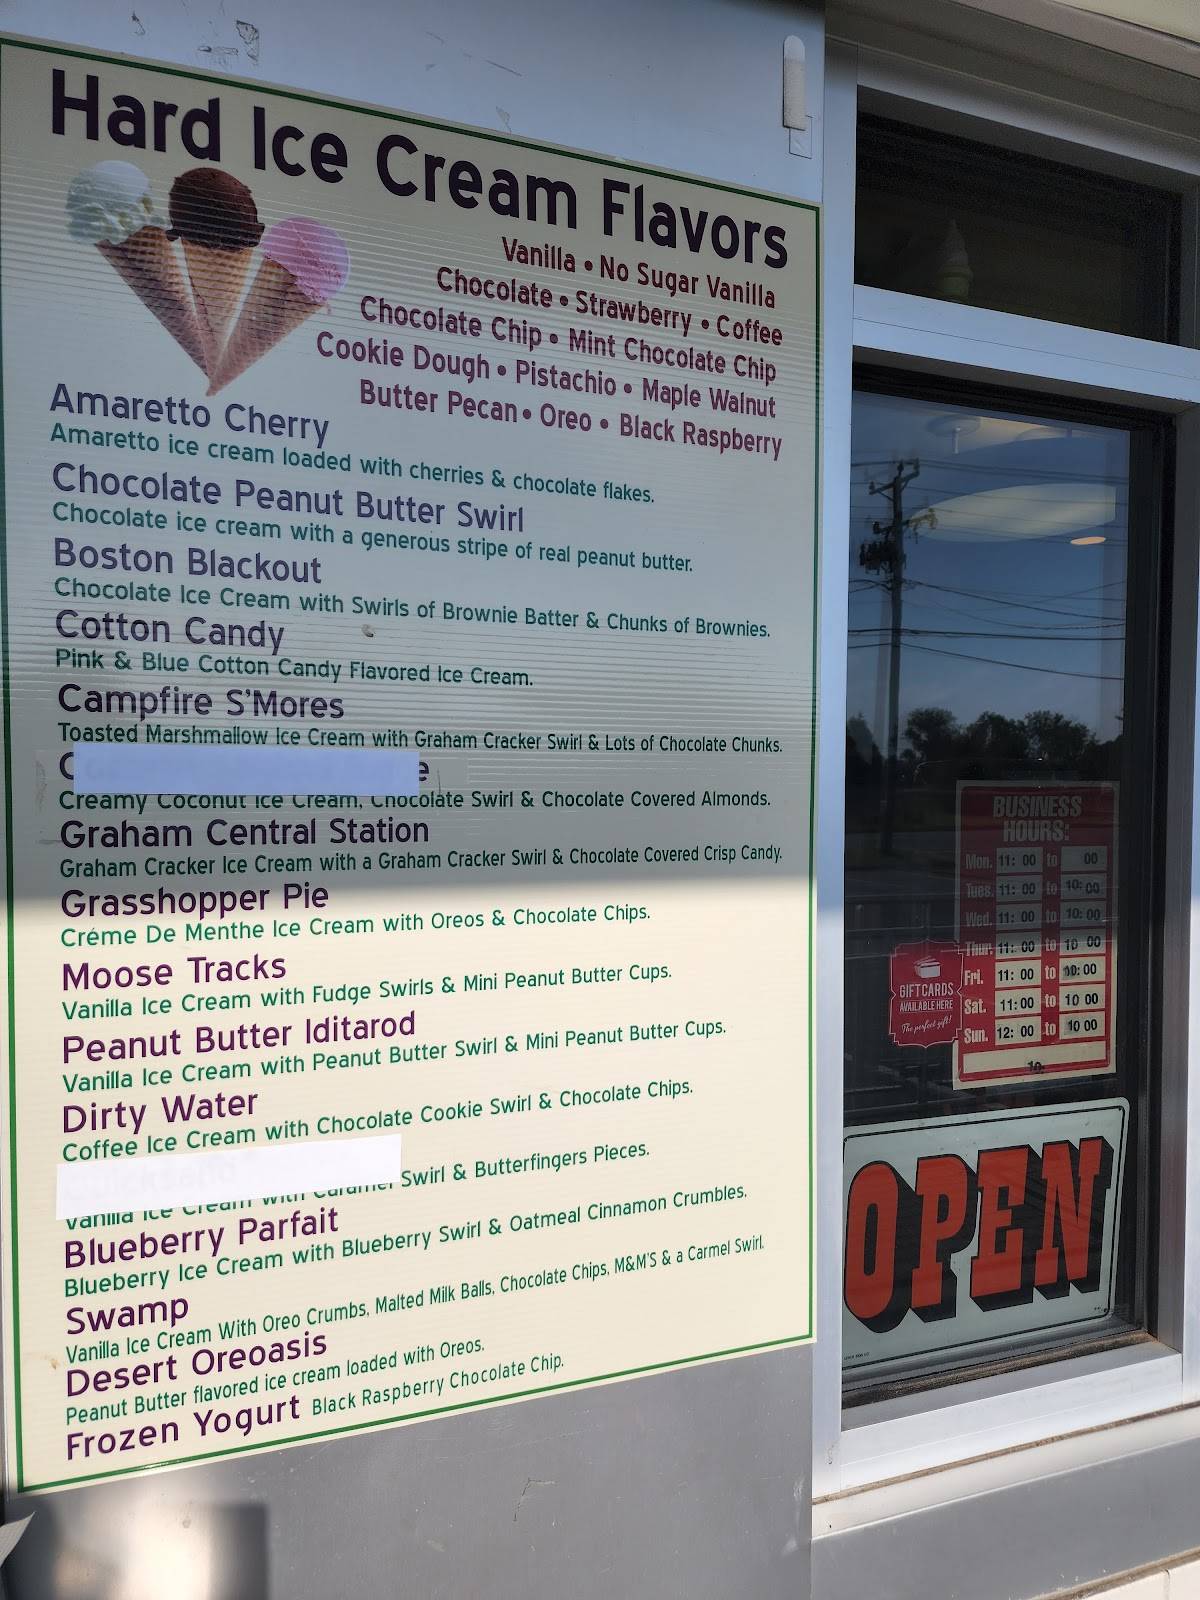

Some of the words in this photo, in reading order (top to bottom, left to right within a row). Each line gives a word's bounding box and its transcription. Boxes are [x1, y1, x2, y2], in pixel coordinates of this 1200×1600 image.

[52, 68, 220, 162] Hard
[254, 105, 348, 183] Ice
[377, 135, 577, 229] Cream
[603, 178, 787, 268] Flavors
[502, 236, 575, 272] Vanilla
[601, 255, 628, 281] No
[638, 263, 699, 297] Sugar
[707, 275, 775, 308] Vanilla
[437, 267, 552, 308] Chocolate
[576, 291, 692, 337] Strawberry
[717, 315, 782, 345] Coffee
[361, 296, 482, 337] Chocolate
[492, 317, 541, 352] Chip
[570, 328, 615, 357] Mint
[625, 338, 725, 373] Chocolate
[734, 355, 776, 387] Chip
[317, 331, 404, 366] Cookie
[414, 345, 489, 383] Dough
[517, 360, 616, 395] Pistachio
[643, 378, 701, 411] Maple
[709, 387, 775, 418] Walnut
[50, 384, 210, 427] Amaretto
[225, 404, 329, 448] Cherry
[361, 379, 438, 412] Butter
[448, 391, 517, 422] Pecan
[540, 403, 591, 431] Oreo
[621, 413, 675, 442] Black
[684, 421, 782, 461] Raspberry
[51, 423, 159, 451] Amaretto
[169, 434, 199, 455] ice
[208, 443, 273, 464] cream
[284, 447, 351, 471] loaded
[360, 457, 402, 477] with
[410, 462, 483, 485] cherries
[492, 470, 506, 487] &
[514, 473, 596, 496] chocolate
[603, 481, 654, 503] flakes.
[53, 463, 221, 504] Chocolate
[236, 480, 343, 515] Peanut
[357, 491, 445, 524] Butter
[458, 502, 523, 532] Swirl
[55, 538, 173, 573] Boston
[189, 548, 321, 583] Blackout
[56, 610, 170, 642] Cotton
[185, 617, 284, 656] Candy
[59, 684, 212, 721] Campfire
[227, 689, 344, 718] S'Mores
[993, 795, 1082, 818] BUSINESS
[61, 820, 191, 848] Graham
[207, 818, 315, 845] Central
[330, 817, 428, 843] Station
[1003, 820, 1070, 842] HOURS:
[1047, 852, 1057, 866] to
[62, 887, 270, 920] Grasshopper
[284, 882, 328, 909] Pie
[147, 925, 175, 943] De
[186, 922, 264, 941] Menthe
[274, 920, 300, 937] Ice
[310, 918, 373, 935] Cream
[383, 914, 423, 931] with
[432, 913, 484, 928] Oreos
[492, 910, 505, 926] &
[514, 907, 596, 924] Chocolate
[604, 904, 650, 924] Chips.
[1045, 938, 1057, 951] to
[63, 963, 172, 990] Moose
[187, 954, 286, 983] Tracks
[965, 970, 984, 986] Fri.
[1045, 965, 1056, 980] to
[900, 1001, 935, 1012] AVAILABLE
[936, 1000, 953, 1010] HERE
[965, 999, 986, 1015] Sat.
[1045, 994, 1056, 1008] to
[64, 1030, 181, 1063] Peanut
[197, 1024, 292, 1053] Butter
[307, 1010, 414, 1044] Iditarod
[964, 1028, 988, 1044] Sun.
[1045, 1021, 1056, 1036] to
[64, 1102, 146, 1134] Dirty
[162, 1093, 258, 1123] Water
[66, 1227, 224, 1268] Blueberry
[240, 1207, 338, 1244] Parfait
[844, 1136, 1114, 1333] OPEN
[66, 1341, 119, 1363] Vanilla
[127, 1337, 150, 1354] Ice
[157, 1329, 211, 1349] Cream
[219, 1318, 256, 1339] With
[263, 1315, 300, 1332] Oreo
[376, 1290, 423, 1314] Malted
[430, 1286, 455, 1304] Milk
[501, 1269, 566, 1292] Chocolate
[615, 1252, 656, 1273] M&M'S
[662, 1250, 671, 1265] &
[677, 1251, 682, 1263] a
[688, 1241, 730, 1260] Carmel
[735, 1235, 764, 1253] Swirl.
[67, 1298, 188, 1334] Swamp
[67, 1355, 177, 1397] Desert
[192, 1331, 326, 1375] Oreoasis
[68, 1422, 178, 1460] Frozen
[193, 1395, 300, 1436] Yogurt
[313, 1393, 356, 1415] Black
[363, 1378, 443, 1406] Raspberry
[450, 1362, 525, 1388] Chocolate
[531, 1356, 563, 1373] Chip.
